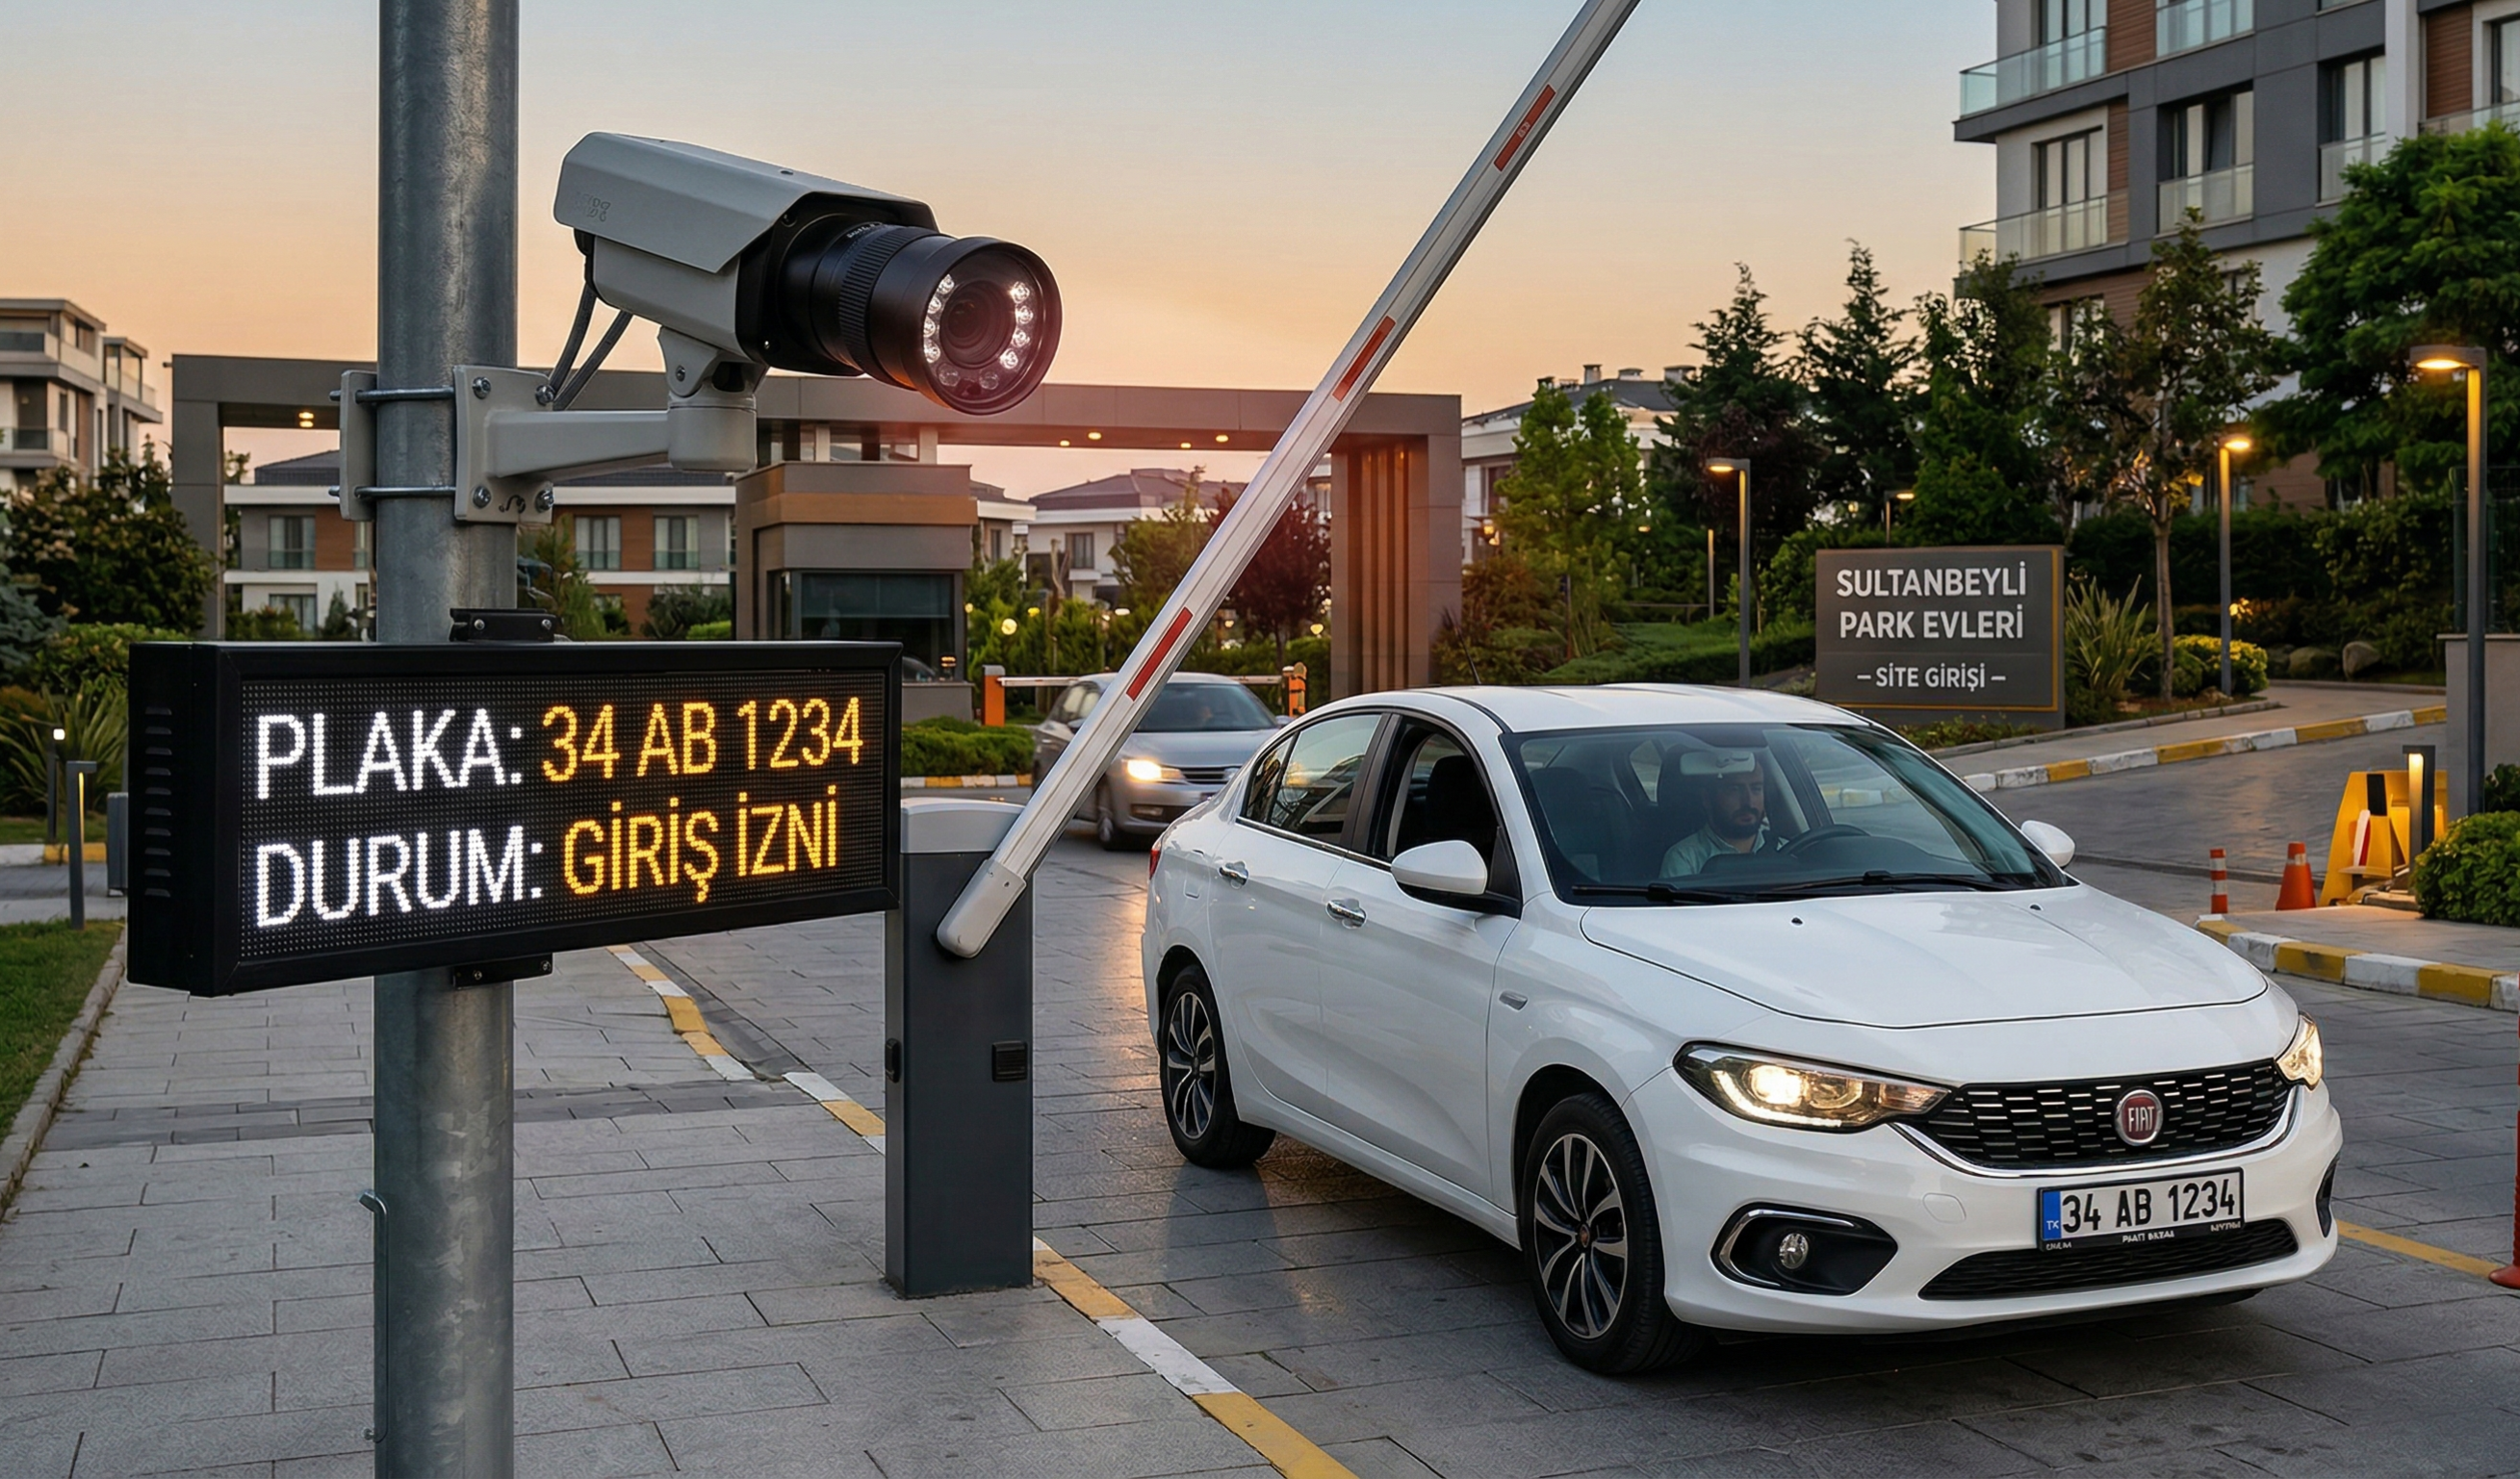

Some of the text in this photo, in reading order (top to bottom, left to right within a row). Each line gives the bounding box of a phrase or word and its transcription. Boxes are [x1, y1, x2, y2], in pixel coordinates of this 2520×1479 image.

[1836, 561, 2026, 598] SULTANBEYLİ
[1839, 603, 2022, 639] PARK EVLERİ
[1876, 662, 1985, 692] SİTE GİRİŞİ
[256, 696, 864, 801] PLAKA: 34 AB 1234
[255, 784, 837, 929] DURUM: GİRİŞ İZNİ
[2127, 1106, 2155, 1133] FIAT
[2062, 1178, 2236, 1234] 34 AB 1234
